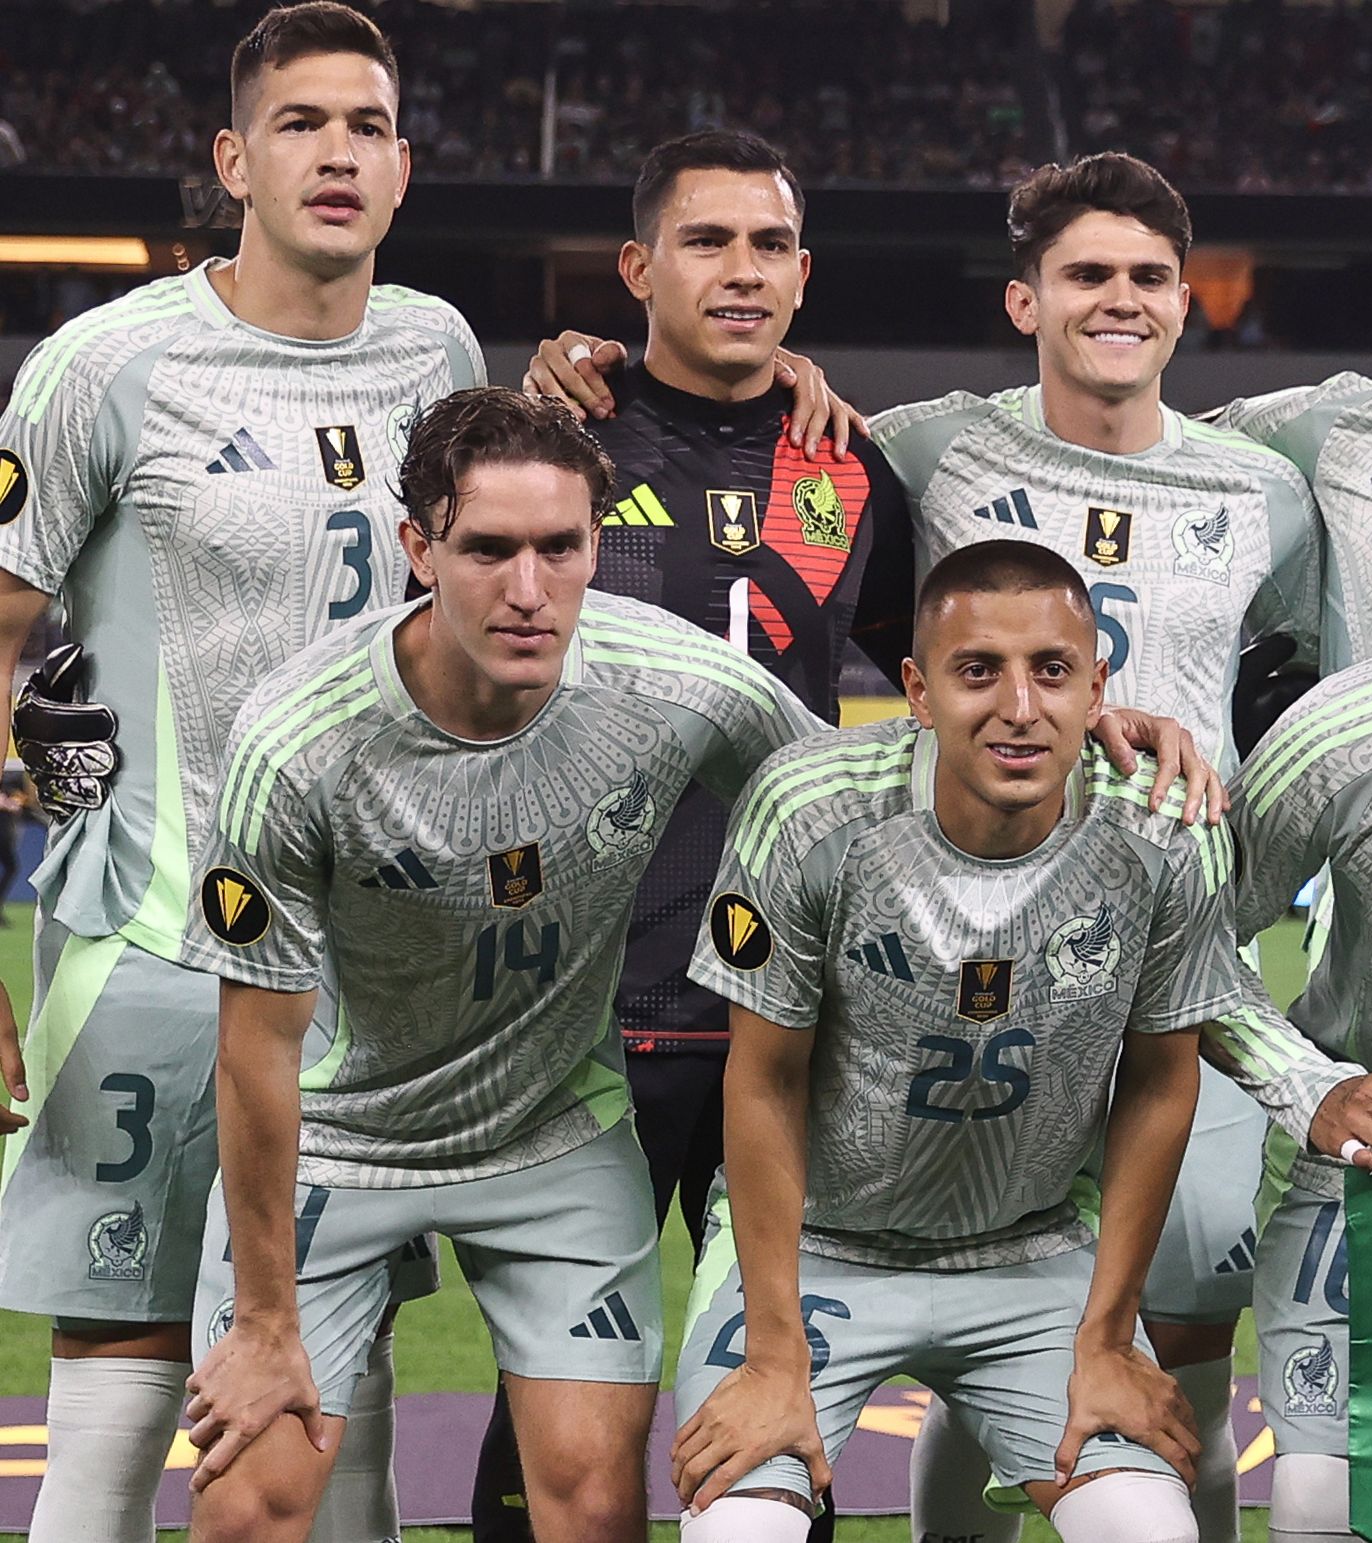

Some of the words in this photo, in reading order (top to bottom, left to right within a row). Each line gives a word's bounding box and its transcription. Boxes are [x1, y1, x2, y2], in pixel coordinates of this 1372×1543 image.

[326, 510, 372, 620] 3
[1177, 562, 1228, 582] MÉXICO
[473, 919, 560, 1002] 14
[1051, 980, 1115, 1000] MÉXICO
[906, 1028, 1036, 1124] 25
[96, 1073, 155, 1182] 3
